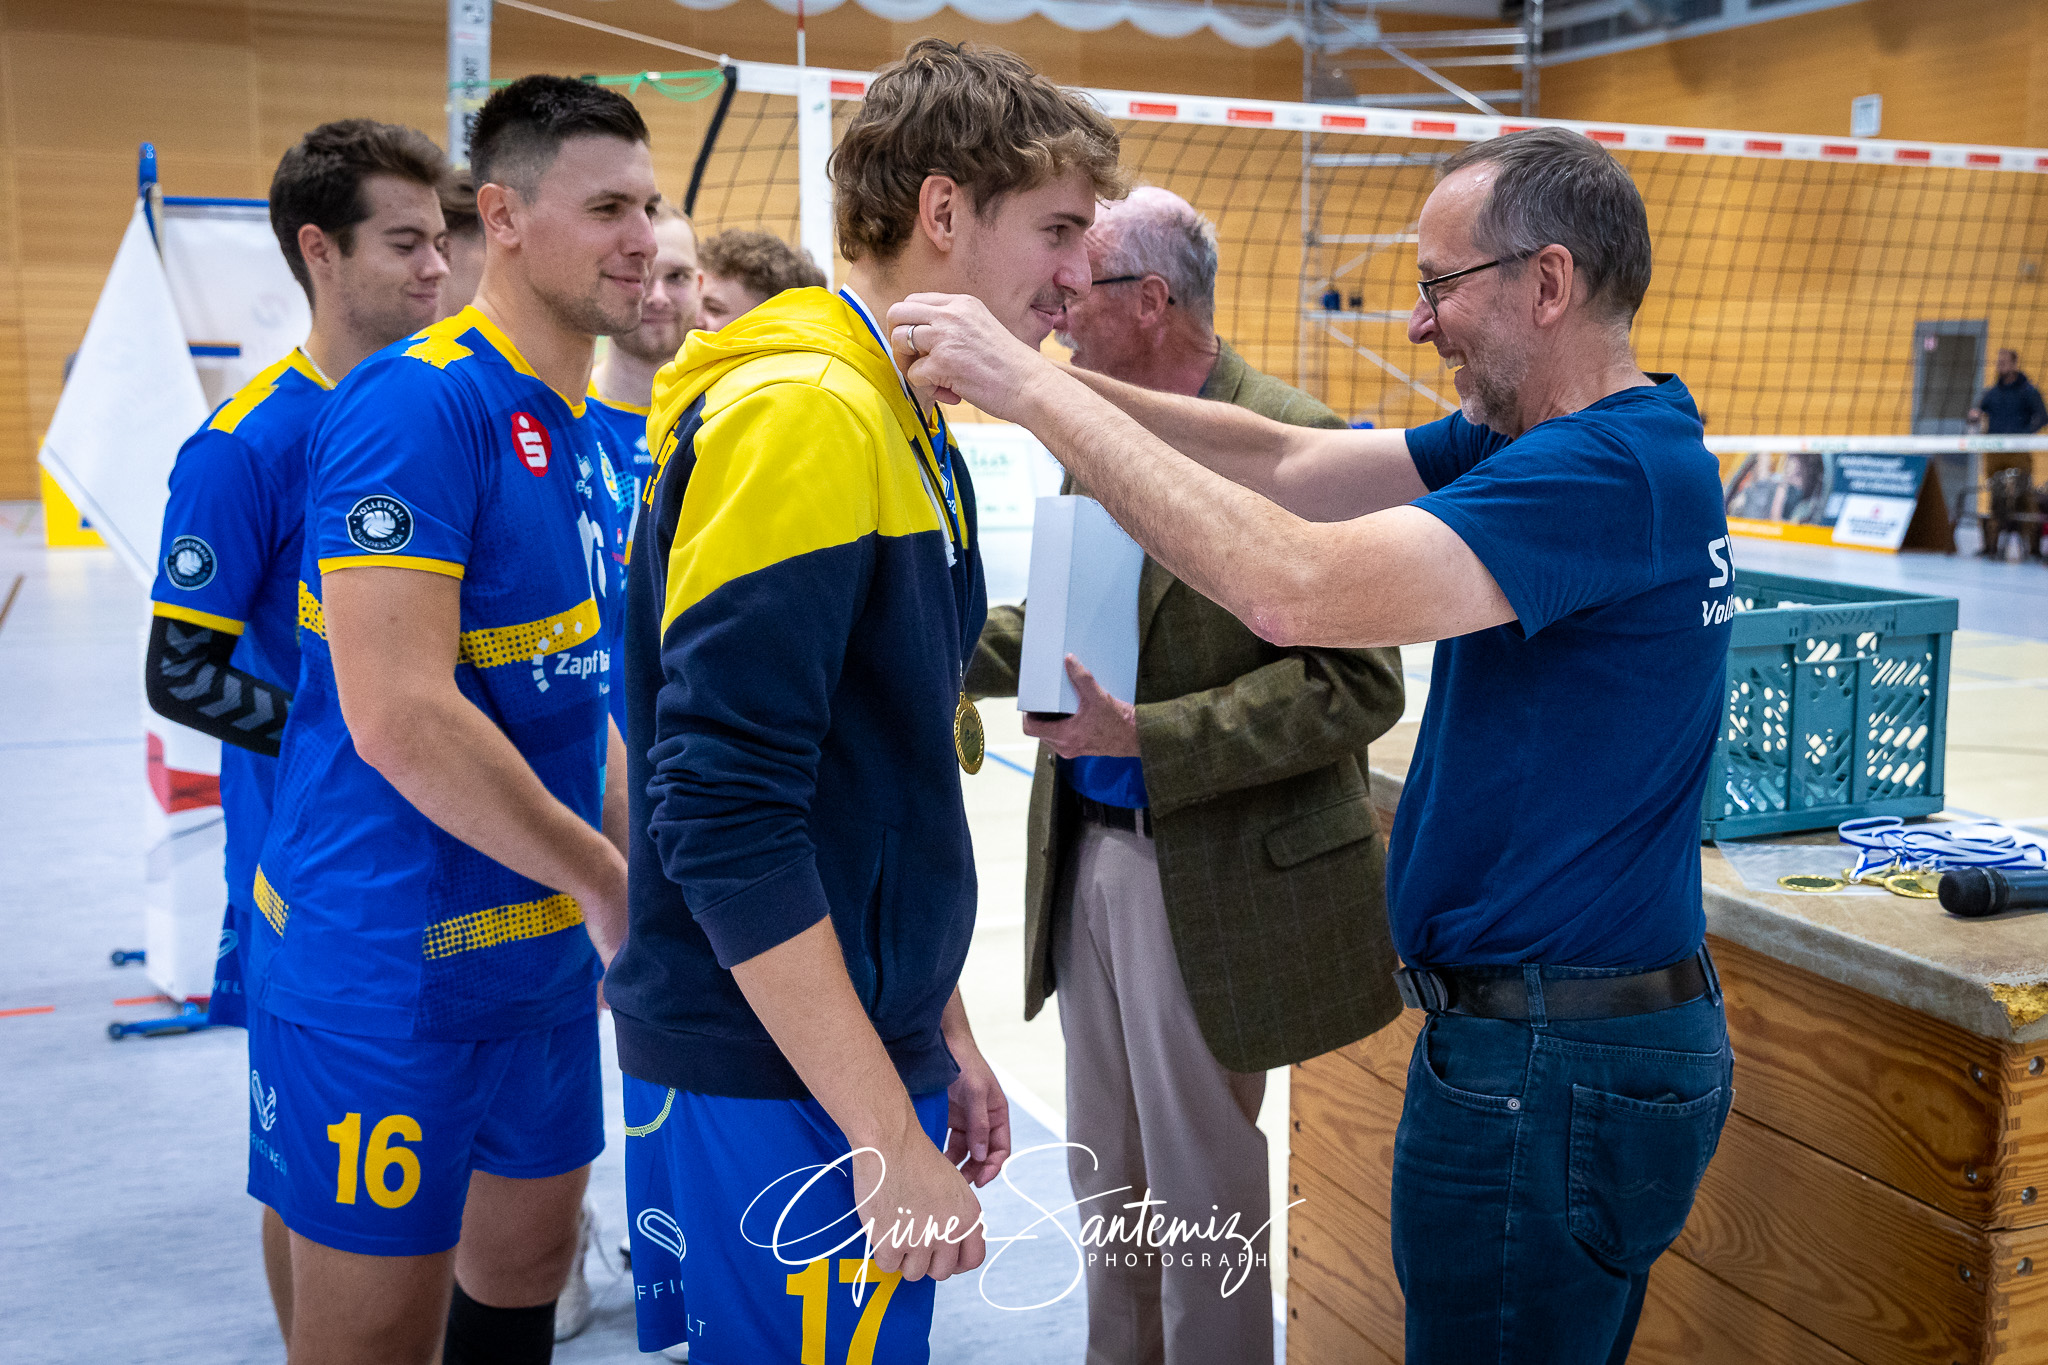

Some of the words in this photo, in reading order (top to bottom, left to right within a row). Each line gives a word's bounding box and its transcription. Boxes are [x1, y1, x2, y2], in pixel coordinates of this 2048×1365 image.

[554, 649, 599, 680] Zapf
[327, 1112, 423, 1209] 16
[786, 1258, 903, 1365] 17
